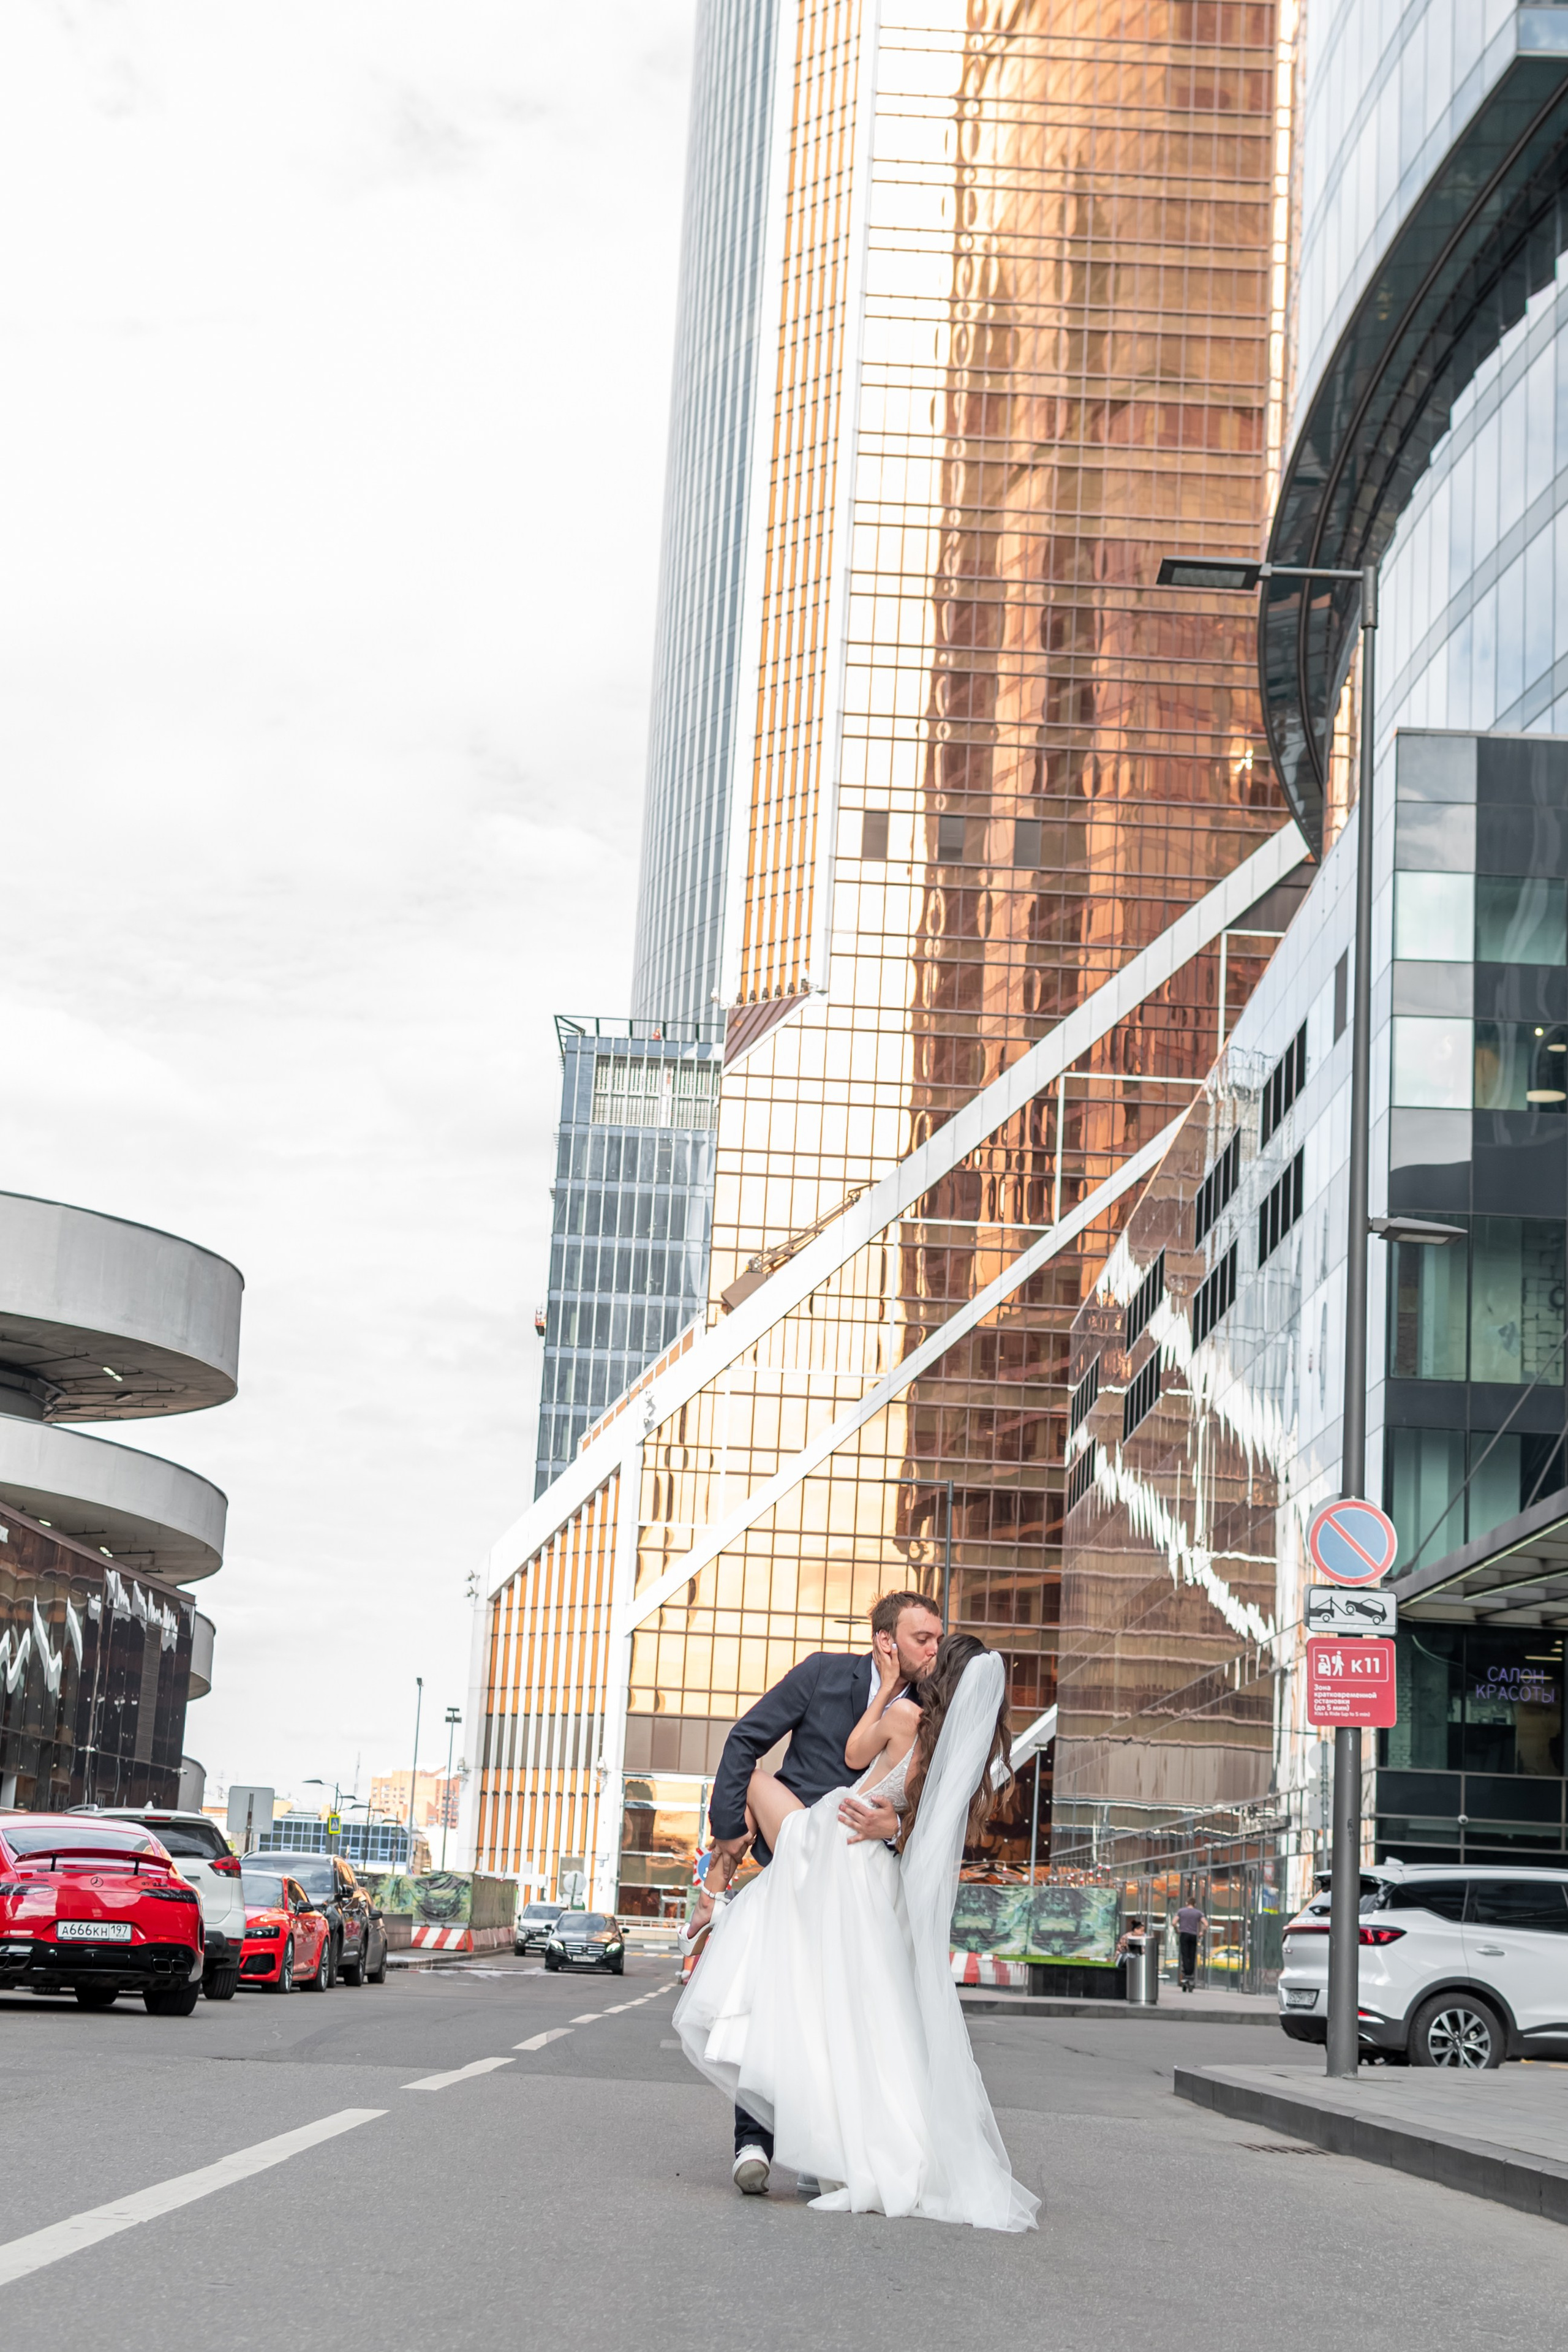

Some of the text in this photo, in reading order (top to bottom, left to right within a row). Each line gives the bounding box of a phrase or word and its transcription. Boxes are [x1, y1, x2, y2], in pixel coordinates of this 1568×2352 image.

[1487, 1666, 1544, 1684] САЛОН
[1476, 1684, 1555, 1703] КРАСОТЫ
[110, 1925, 128, 1934] 197
